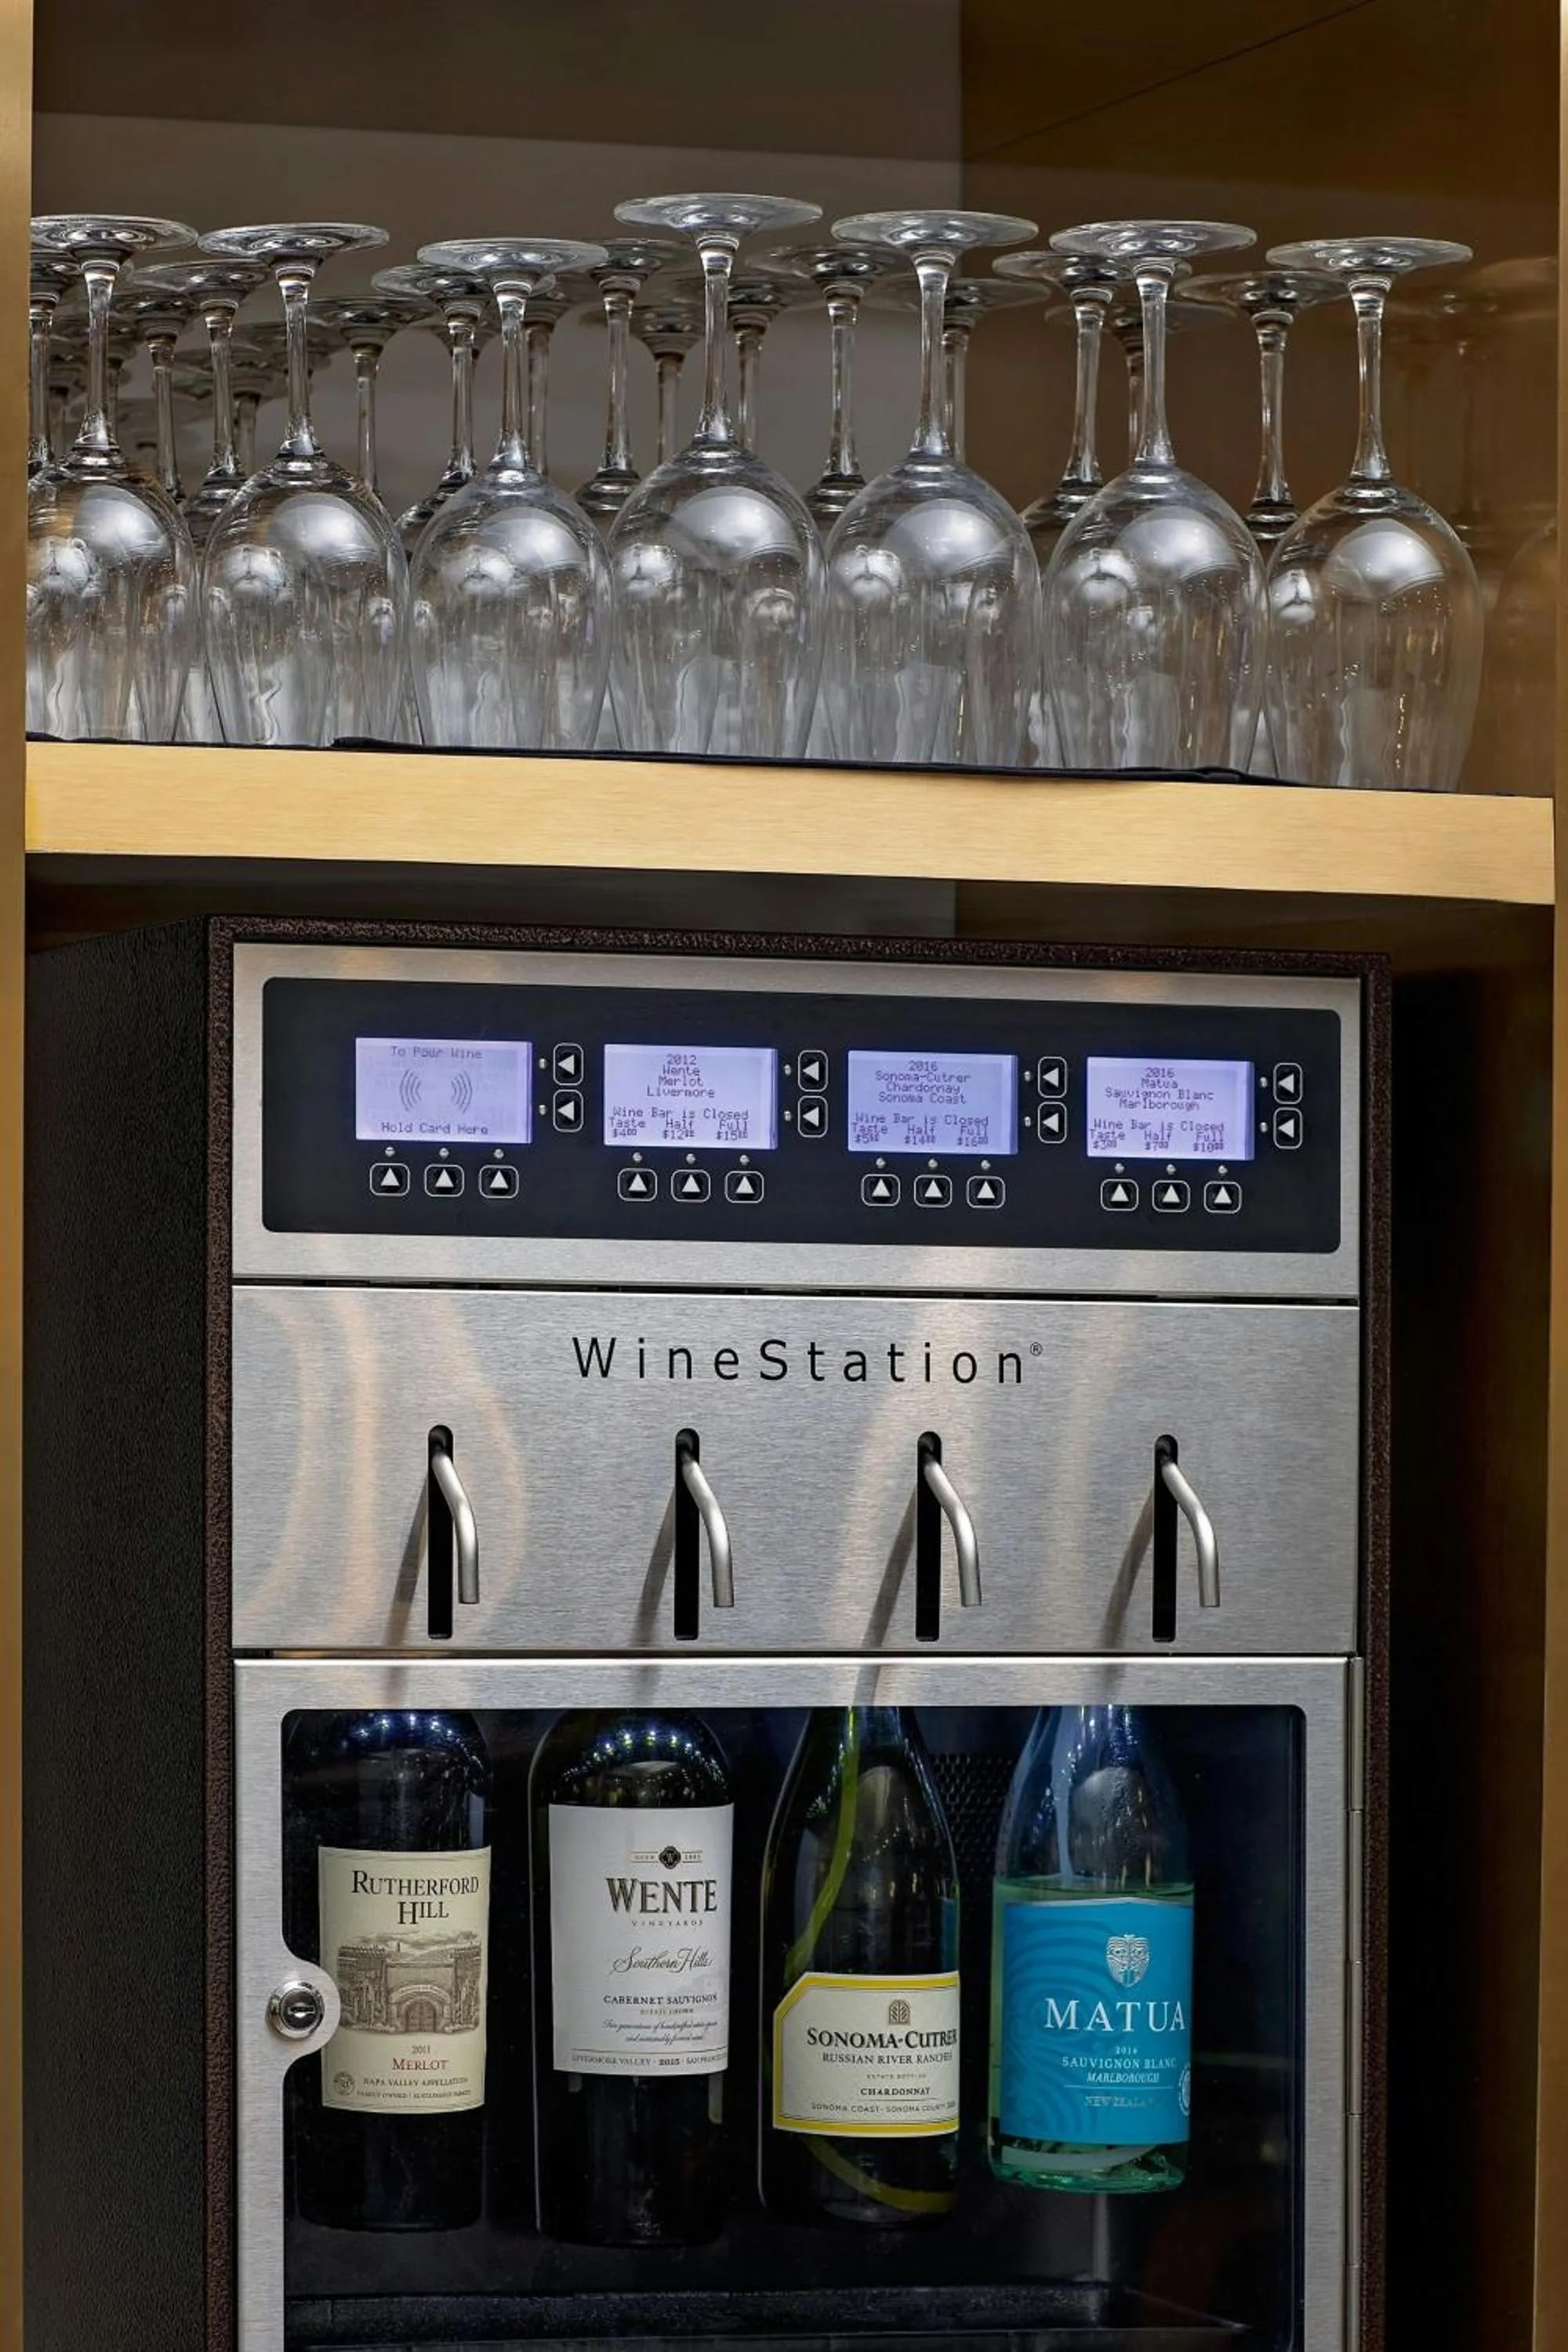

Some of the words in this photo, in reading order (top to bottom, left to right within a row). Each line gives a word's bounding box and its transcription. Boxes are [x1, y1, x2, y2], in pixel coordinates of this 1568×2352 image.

[391, 1046, 406, 1058] To
[413, 1046, 442, 1058] Pour
[451, 1047, 483, 1058] Wine
[666, 1054, 697, 1065] 2012
[662, 1065, 701, 1076] Wente
[909, 1061, 938, 1072] 2016
[876, 1071, 972, 1083] Sonoma-Cutrer
[1145, 1068, 1174, 1078] 2016
[659, 1076, 704, 1087] Merlot
[886, 1082, 960, 1093] Chardonnay
[1141, 1078, 1178, 1088] Matua
[647, 1087, 715, 1098] Livermore
[879, 1092, 923, 1103] Sonoma
[931, 1093, 967, 1104] Coast
[1105, 1087, 1171, 1098] Sauvignon
[1178, 1090, 1214, 1100] Blanc
[1119, 1099, 1200, 1111] Marlborough
[613, 1107, 644, 1117] Wine
[652, 1107, 673, 1118] Bar
[682, 1108, 696, 1119] is
[703, 1109, 749, 1120] Closed
[855, 1112, 886, 1123] Wine
[893, 1113, 915, 1123] Bar
[924, 1115, 937, 1125] is
[945, 1115, 989, 1126] Closed
[381, 1122, 412, 1133] Hold
[419, 1123, 450, 1134] Card
[458, 1124, 488, 1134] Here
[609, 1117, 647, 1128] Taste
[666, 1120, 694, 1130] Half
[720, 1120, 748, 1131] Full
[851, 1123, 887, 1134] Taste
[908, 1125, 936, 1134] Half
[960, 1126, 988, 1137] Full
[1094, 1119, 1123, 1130] Wine
[1131, 1120, 1152, 1129] Bar
[1161, 1120, 1174, 1131] is
[1180, 1121, 1225, 1131] Closed
[1091, 1129, 1126, 1140] Taste
[1144, 1131, 1172, 1141] Half
[1196, 1133, 1223, 1142] Full
[351, 1870, 479, 1895] RUTHERFORD
[605, 1878, 717, 1913] WENTE
[397, 1902, 449, 1924] HILL
[609, 1946, 681, 1976] Southern
[603, 1995, 664, 2005] CABERNET
[667, 1993, 717, 2005] SAUVIGNON
[1044, 1998, 1185, 2032] MATUA
[807, 2027, 956, 2048] SONOMA-CUTRER
[392, 2058, 448, 2071] MERLOT
[620, 2057, 651, 2066] VALLEY
[822, 2053, 874, 2063] RUSSIAN
[878, 2055, 913, 2064] RIVER
[1062, 2057, 1140, 2068] SAUVIGNON
[1144, 2057, 1177, 2068] BLANC
[1087, 2072, 1160, 2082] MARLBOROUGH
[861, 2087, 930, 2096] CHARDONNAY
